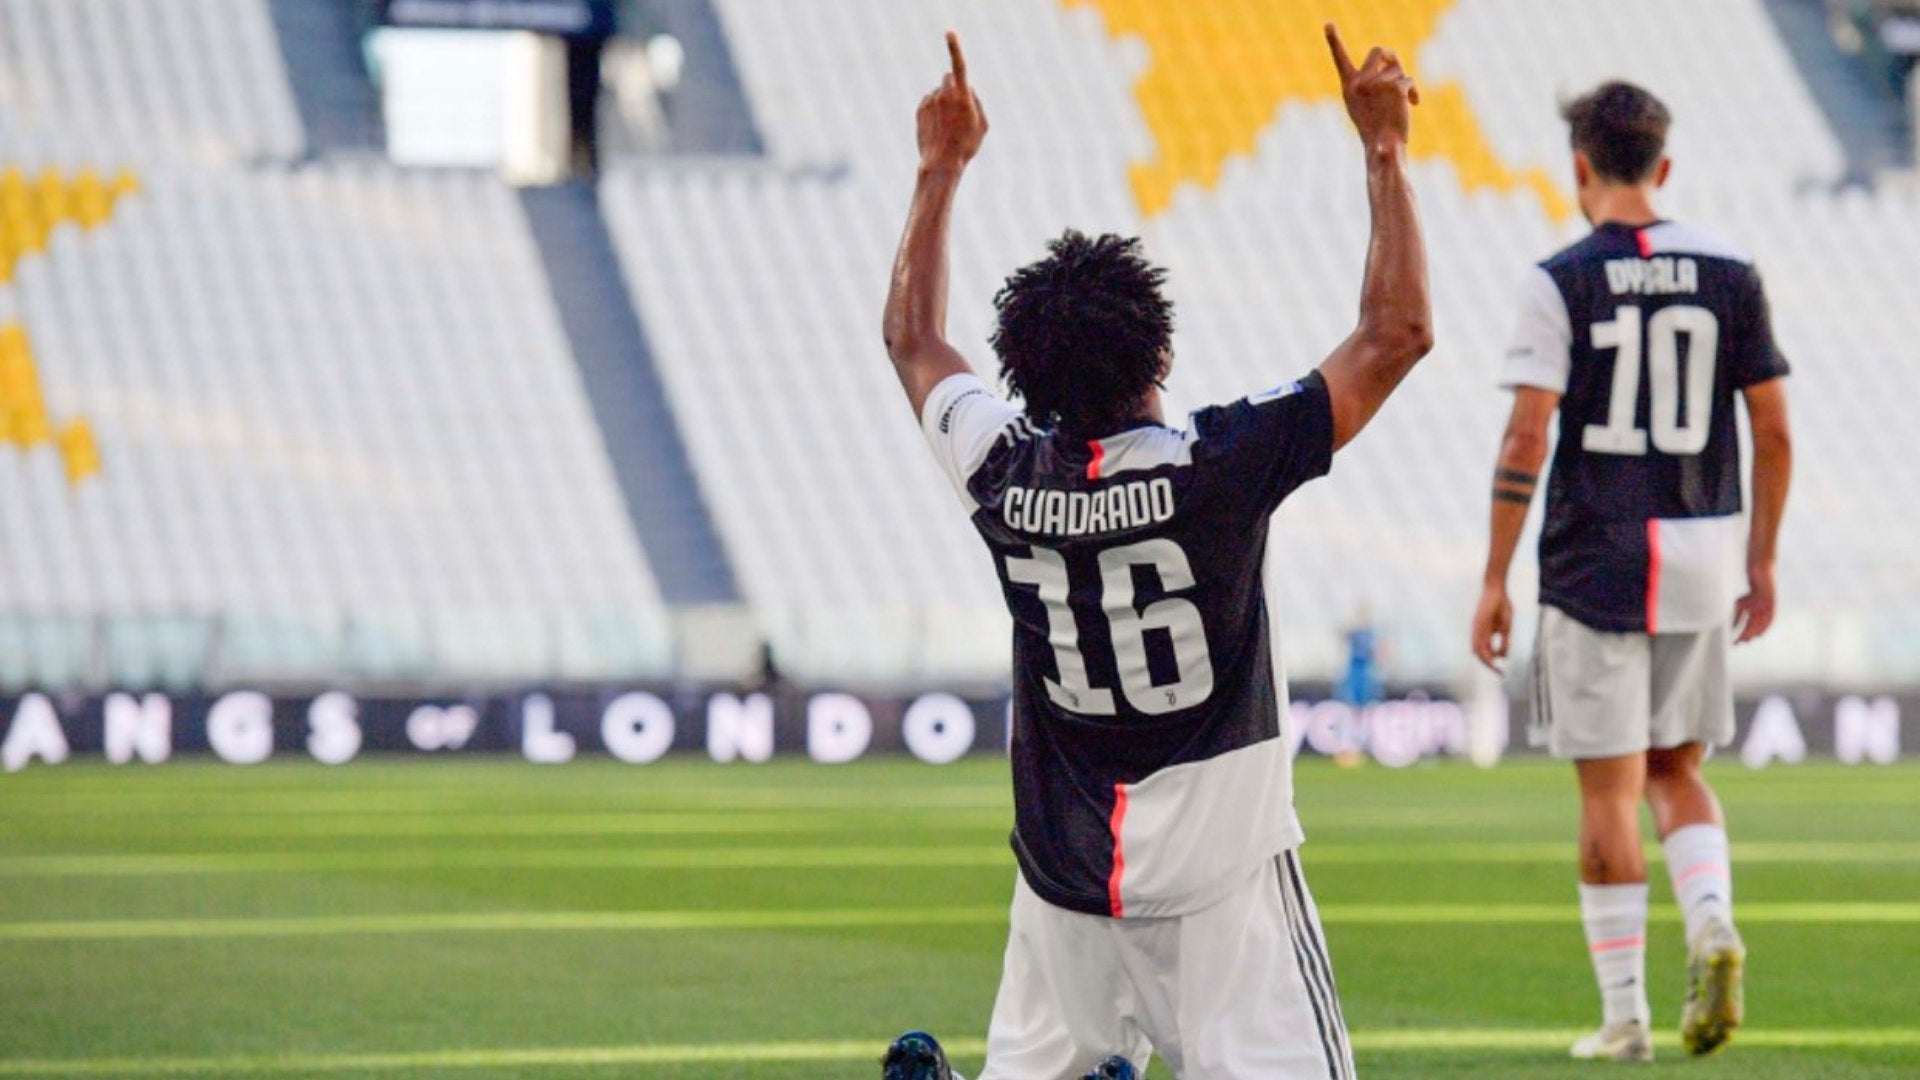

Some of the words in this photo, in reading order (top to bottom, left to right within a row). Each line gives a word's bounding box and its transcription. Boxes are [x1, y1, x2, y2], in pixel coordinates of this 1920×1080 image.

[1582, 304, 1719, 456] 10
[1003, 477, 1175, 537] CUADRADO
[1005, 537, 1215, 716] 16
[521, 690, 1013, 764] LONDO
